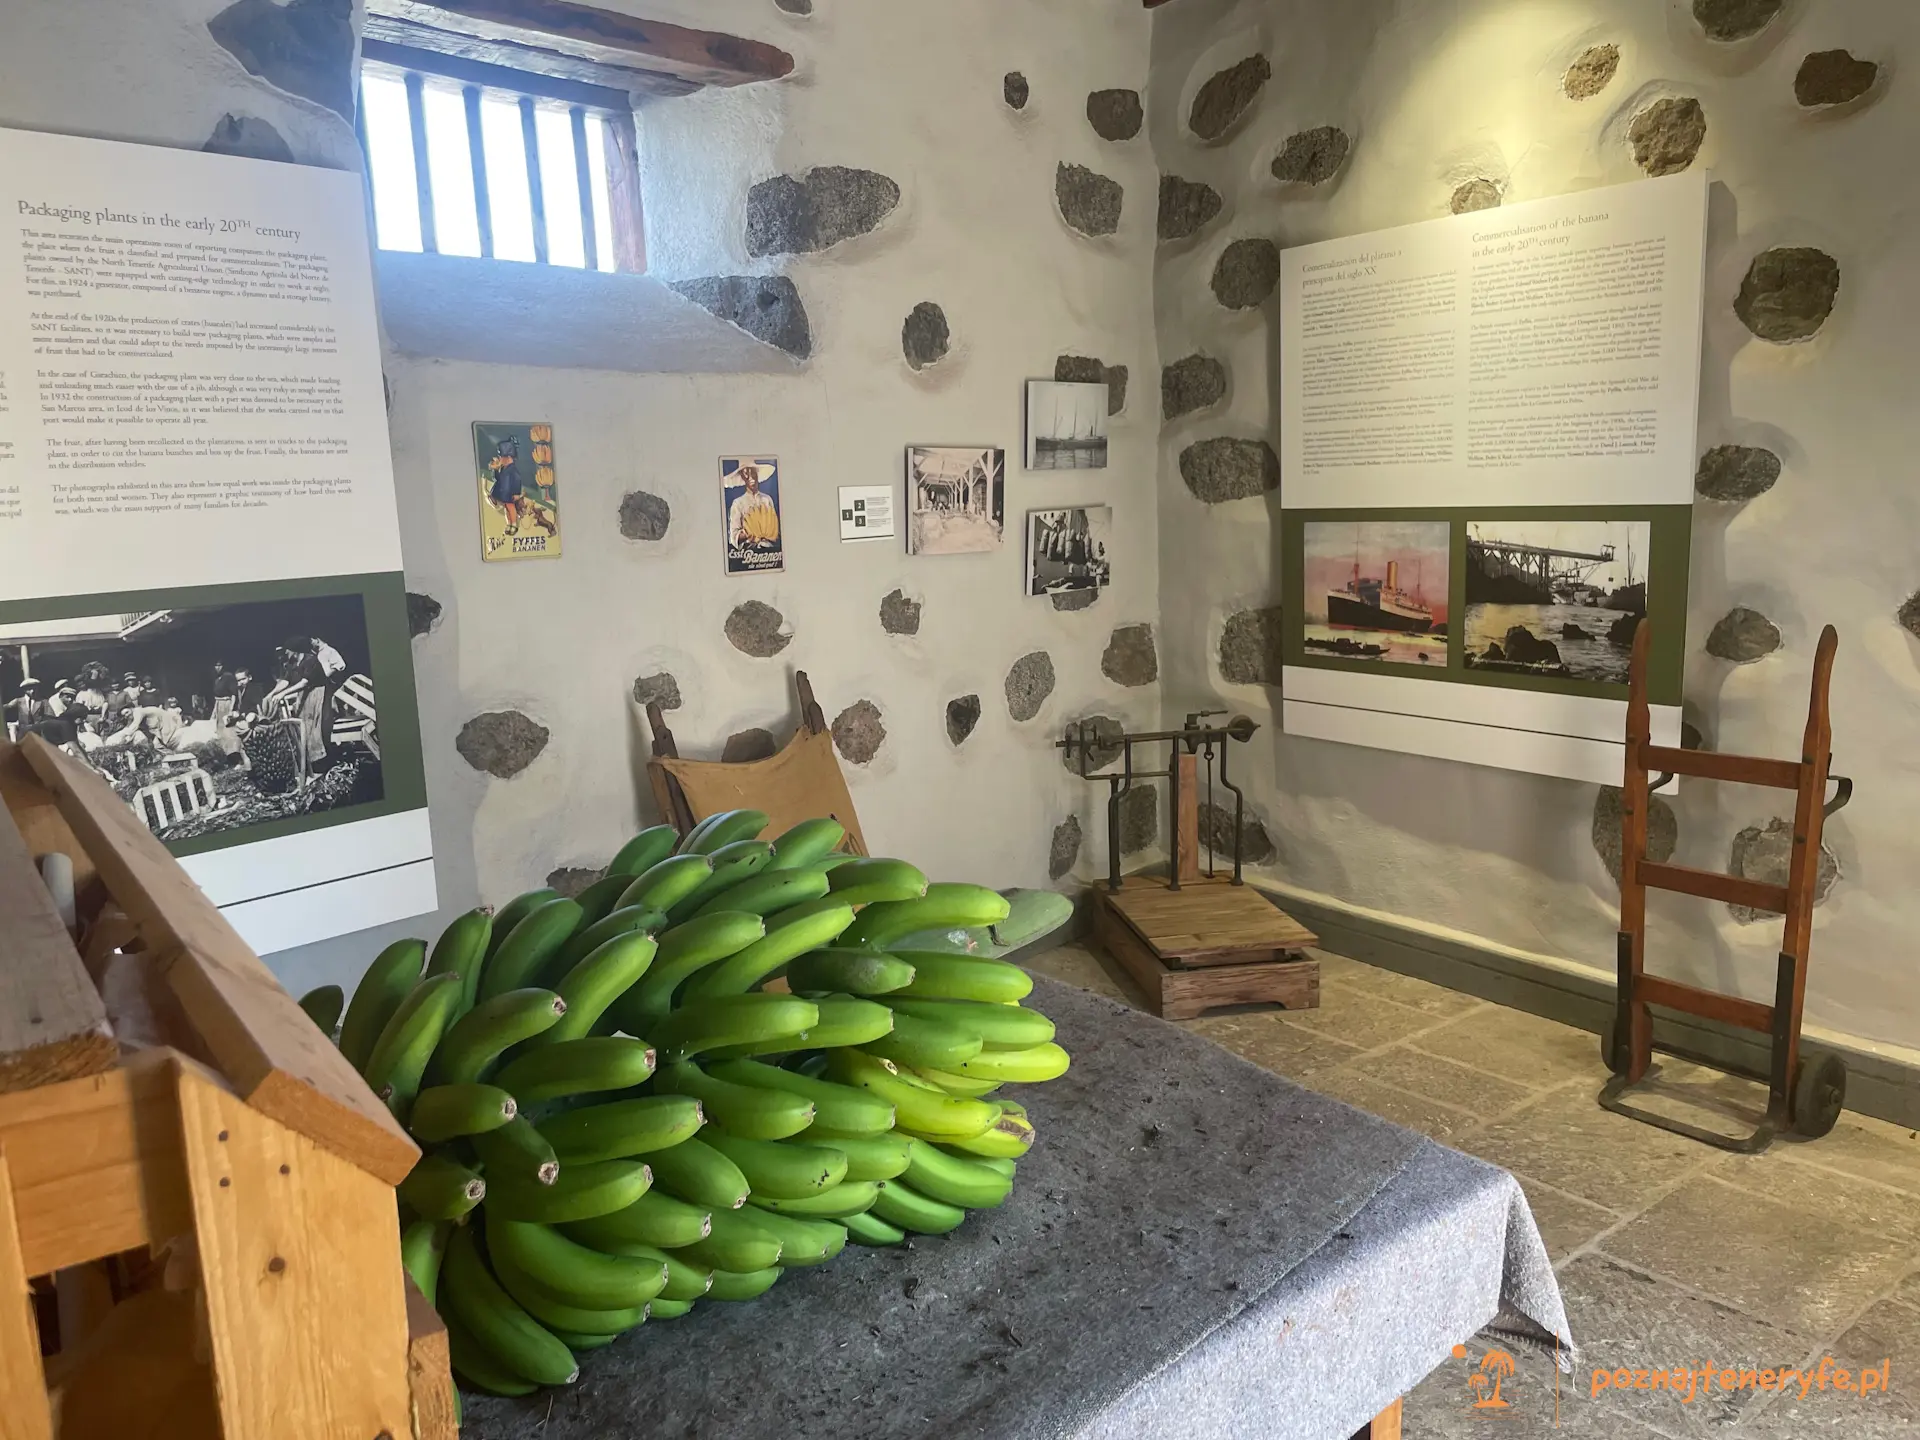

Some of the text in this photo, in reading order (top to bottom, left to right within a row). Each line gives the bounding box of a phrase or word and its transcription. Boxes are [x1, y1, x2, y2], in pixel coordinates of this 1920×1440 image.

[18, 200, 92, 225] Packaging
[96, 208, 138, 226] plants
[142, 211, 156, 226] in
[160, 213, 181, 228] the
[185, 217, 215, 236] early
[256, 226, 301, 243] century
[1549, 220, 1559, 230] of
[1562, 217, 1576, 228] the
[1578, 212, 1609, 225] banana
[1472, 248, 1480, 258] in
[1482, 245, 1494, 256] the
[1496, 242, 1515, 256] early
[1539, 234, 1571, 248] century
[1359, 253, 1369, 263] del
[1335, 271, 1346, 280] del
[1364, 266, 1378, 276] XX
[513, 536, 546, 546] FYFFES
[729, 549, 745, 559] Esst
